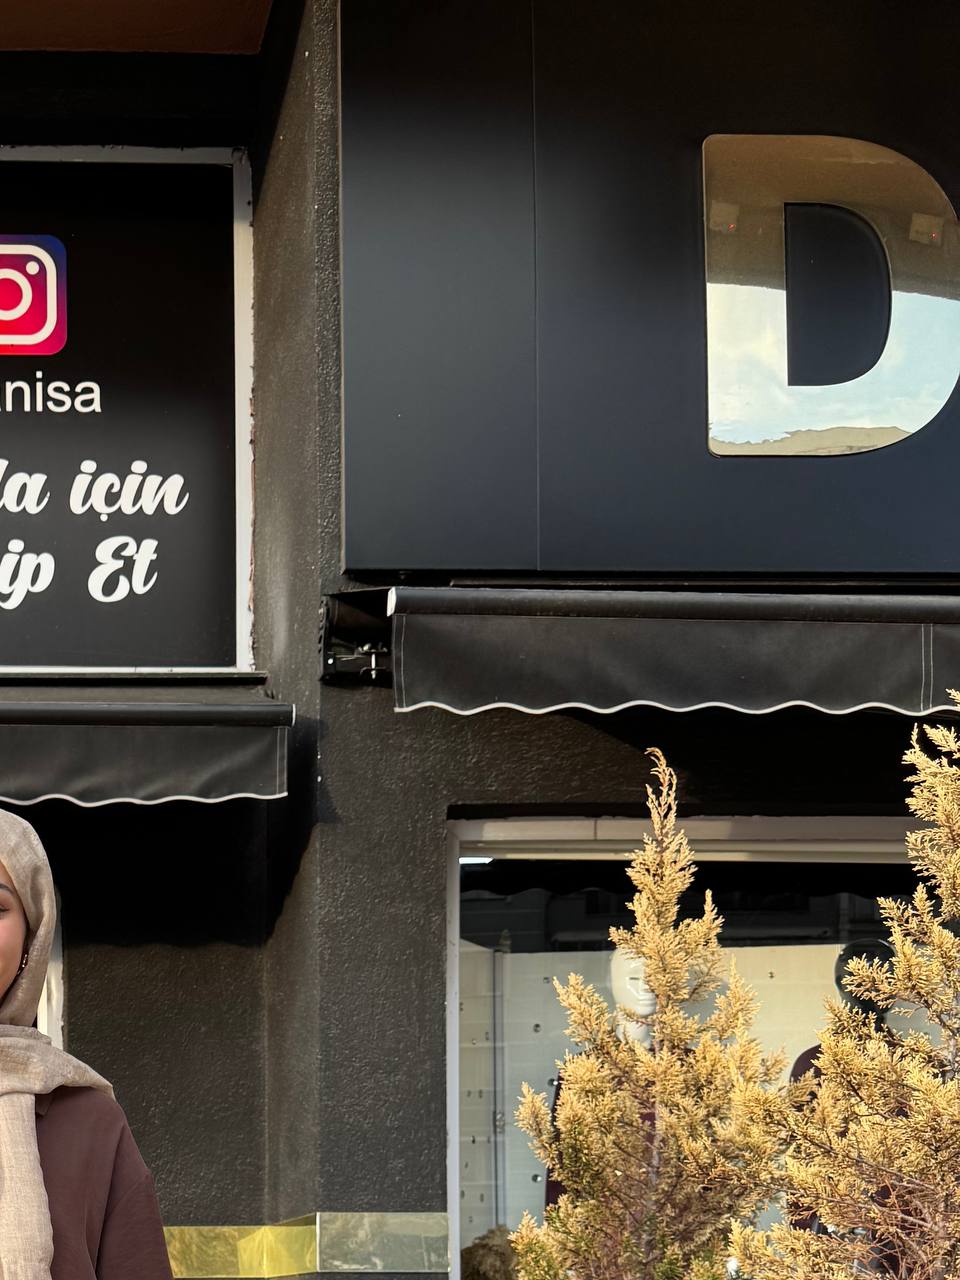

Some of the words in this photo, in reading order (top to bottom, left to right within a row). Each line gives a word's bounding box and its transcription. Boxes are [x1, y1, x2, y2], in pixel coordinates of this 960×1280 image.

[702, 134, 960, 457] D
[70, 460, 189, 521] için
[88, 536, 158, 602] Et
